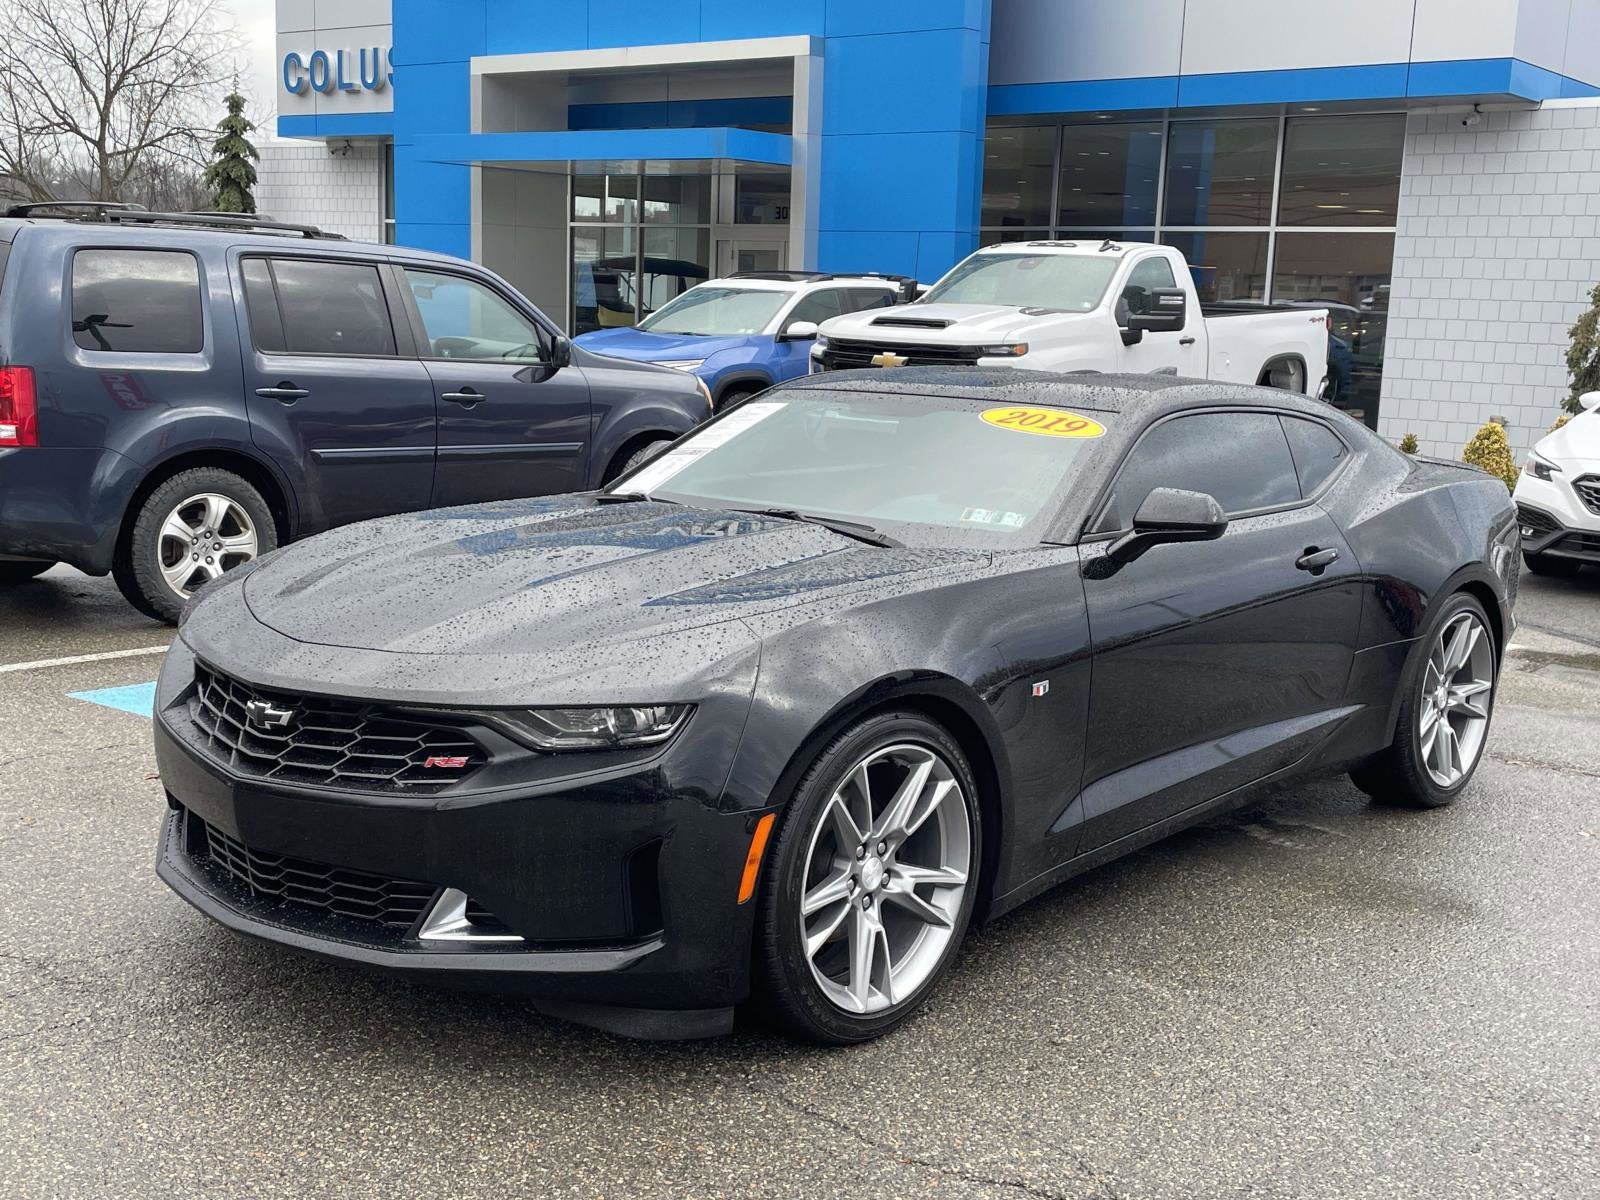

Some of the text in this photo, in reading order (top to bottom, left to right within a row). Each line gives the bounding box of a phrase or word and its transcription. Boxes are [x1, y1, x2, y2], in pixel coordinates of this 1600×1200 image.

[775, 206, 790, 220] 30
[995, 410, 1089, 432] 2019
[423, 756, 469, 768] RS
